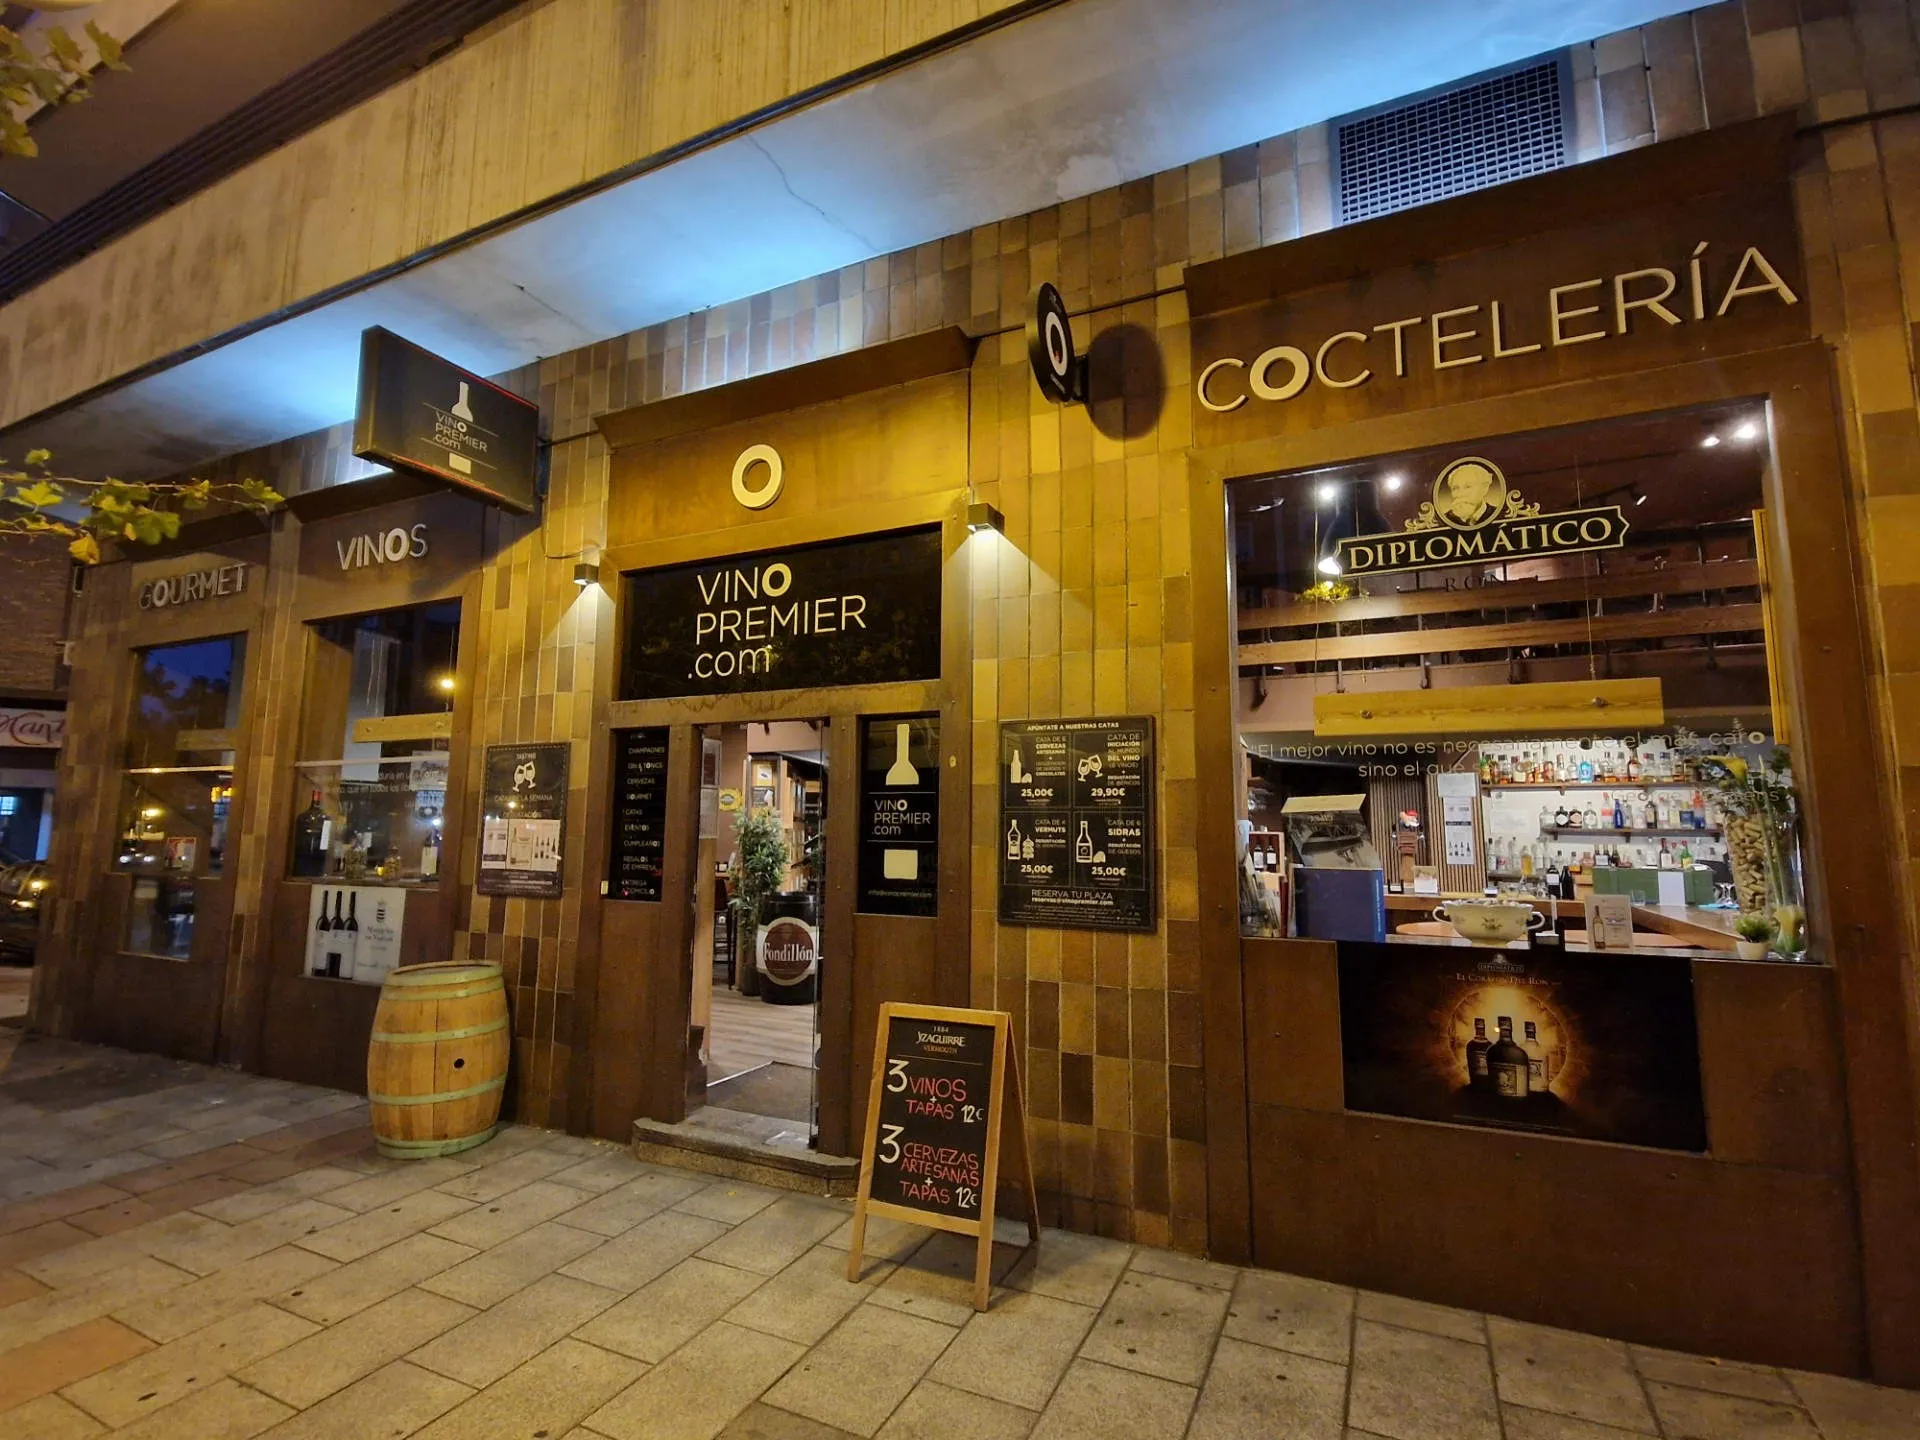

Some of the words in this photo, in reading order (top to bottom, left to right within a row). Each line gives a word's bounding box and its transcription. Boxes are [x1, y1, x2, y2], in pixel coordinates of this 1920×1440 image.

[1197, 241, 1799, 413] COCTELERÍA
[435, 410, 468, 433] VINO
[435, 422, 488, 453] PREMIER
[336, 523, 428, 571] VINOS
[1349, 516, 1612, 570] DIPLOMÁTICO
[138, 562, 249, 611] GOURMET
[696, 562, 792, 606] VINO
[696, 594, 867, 646] PREMIER
[687, 644, 771, 680] .com
[1107, 733, 1127, 741] CATA
[1129, 732, 1140, 740] DE
[1280, 743, 1332, 760] mejor
[1337, 740, 1377, 757] vino
[1383, 742, 1409, 756] no
[1414, 741, 1436, 755] es
[1708, 730, 1767, 747] caro
[1107, 754, 1121, 762] DEL
[1358, 761, 1397, 777] sino
[1403, 760, 1420, 775] el
[1020, 788, 1054, 798] 25,00€
[1090, 787, 1126, 798] 29,90€
[873, 799, 908, 812] VINO
[873, 812, 931, 825] PREMIER
[1107, 828, 1142, 837] SIDRAS
[1020, 864, 1054, 874] 25,00€
[1091, 866, 1127, 876] 25,00€
[1031, 889, 1069, 898] RESERVA
[1071, 891, 1082, 899] TU
[1084, 892, 1113, 900] PLAZA
[763, 941, 814, 962] Fondillón
[915, 1030, 967, 1048] YZAGUIRRE
[886, 1058, 911, 1094] 3
[909, 1075, 967, 1103] VINOS
[905, 1099, 955, 1121] TAPAS
[879, 1122, 905, 1165] 3
[903, 1141, 980, 1172] CERVEZAS
[900, 1161, 980, 1188] ARTESANAS
[899, 1180, 952, 1205] TAPAS
